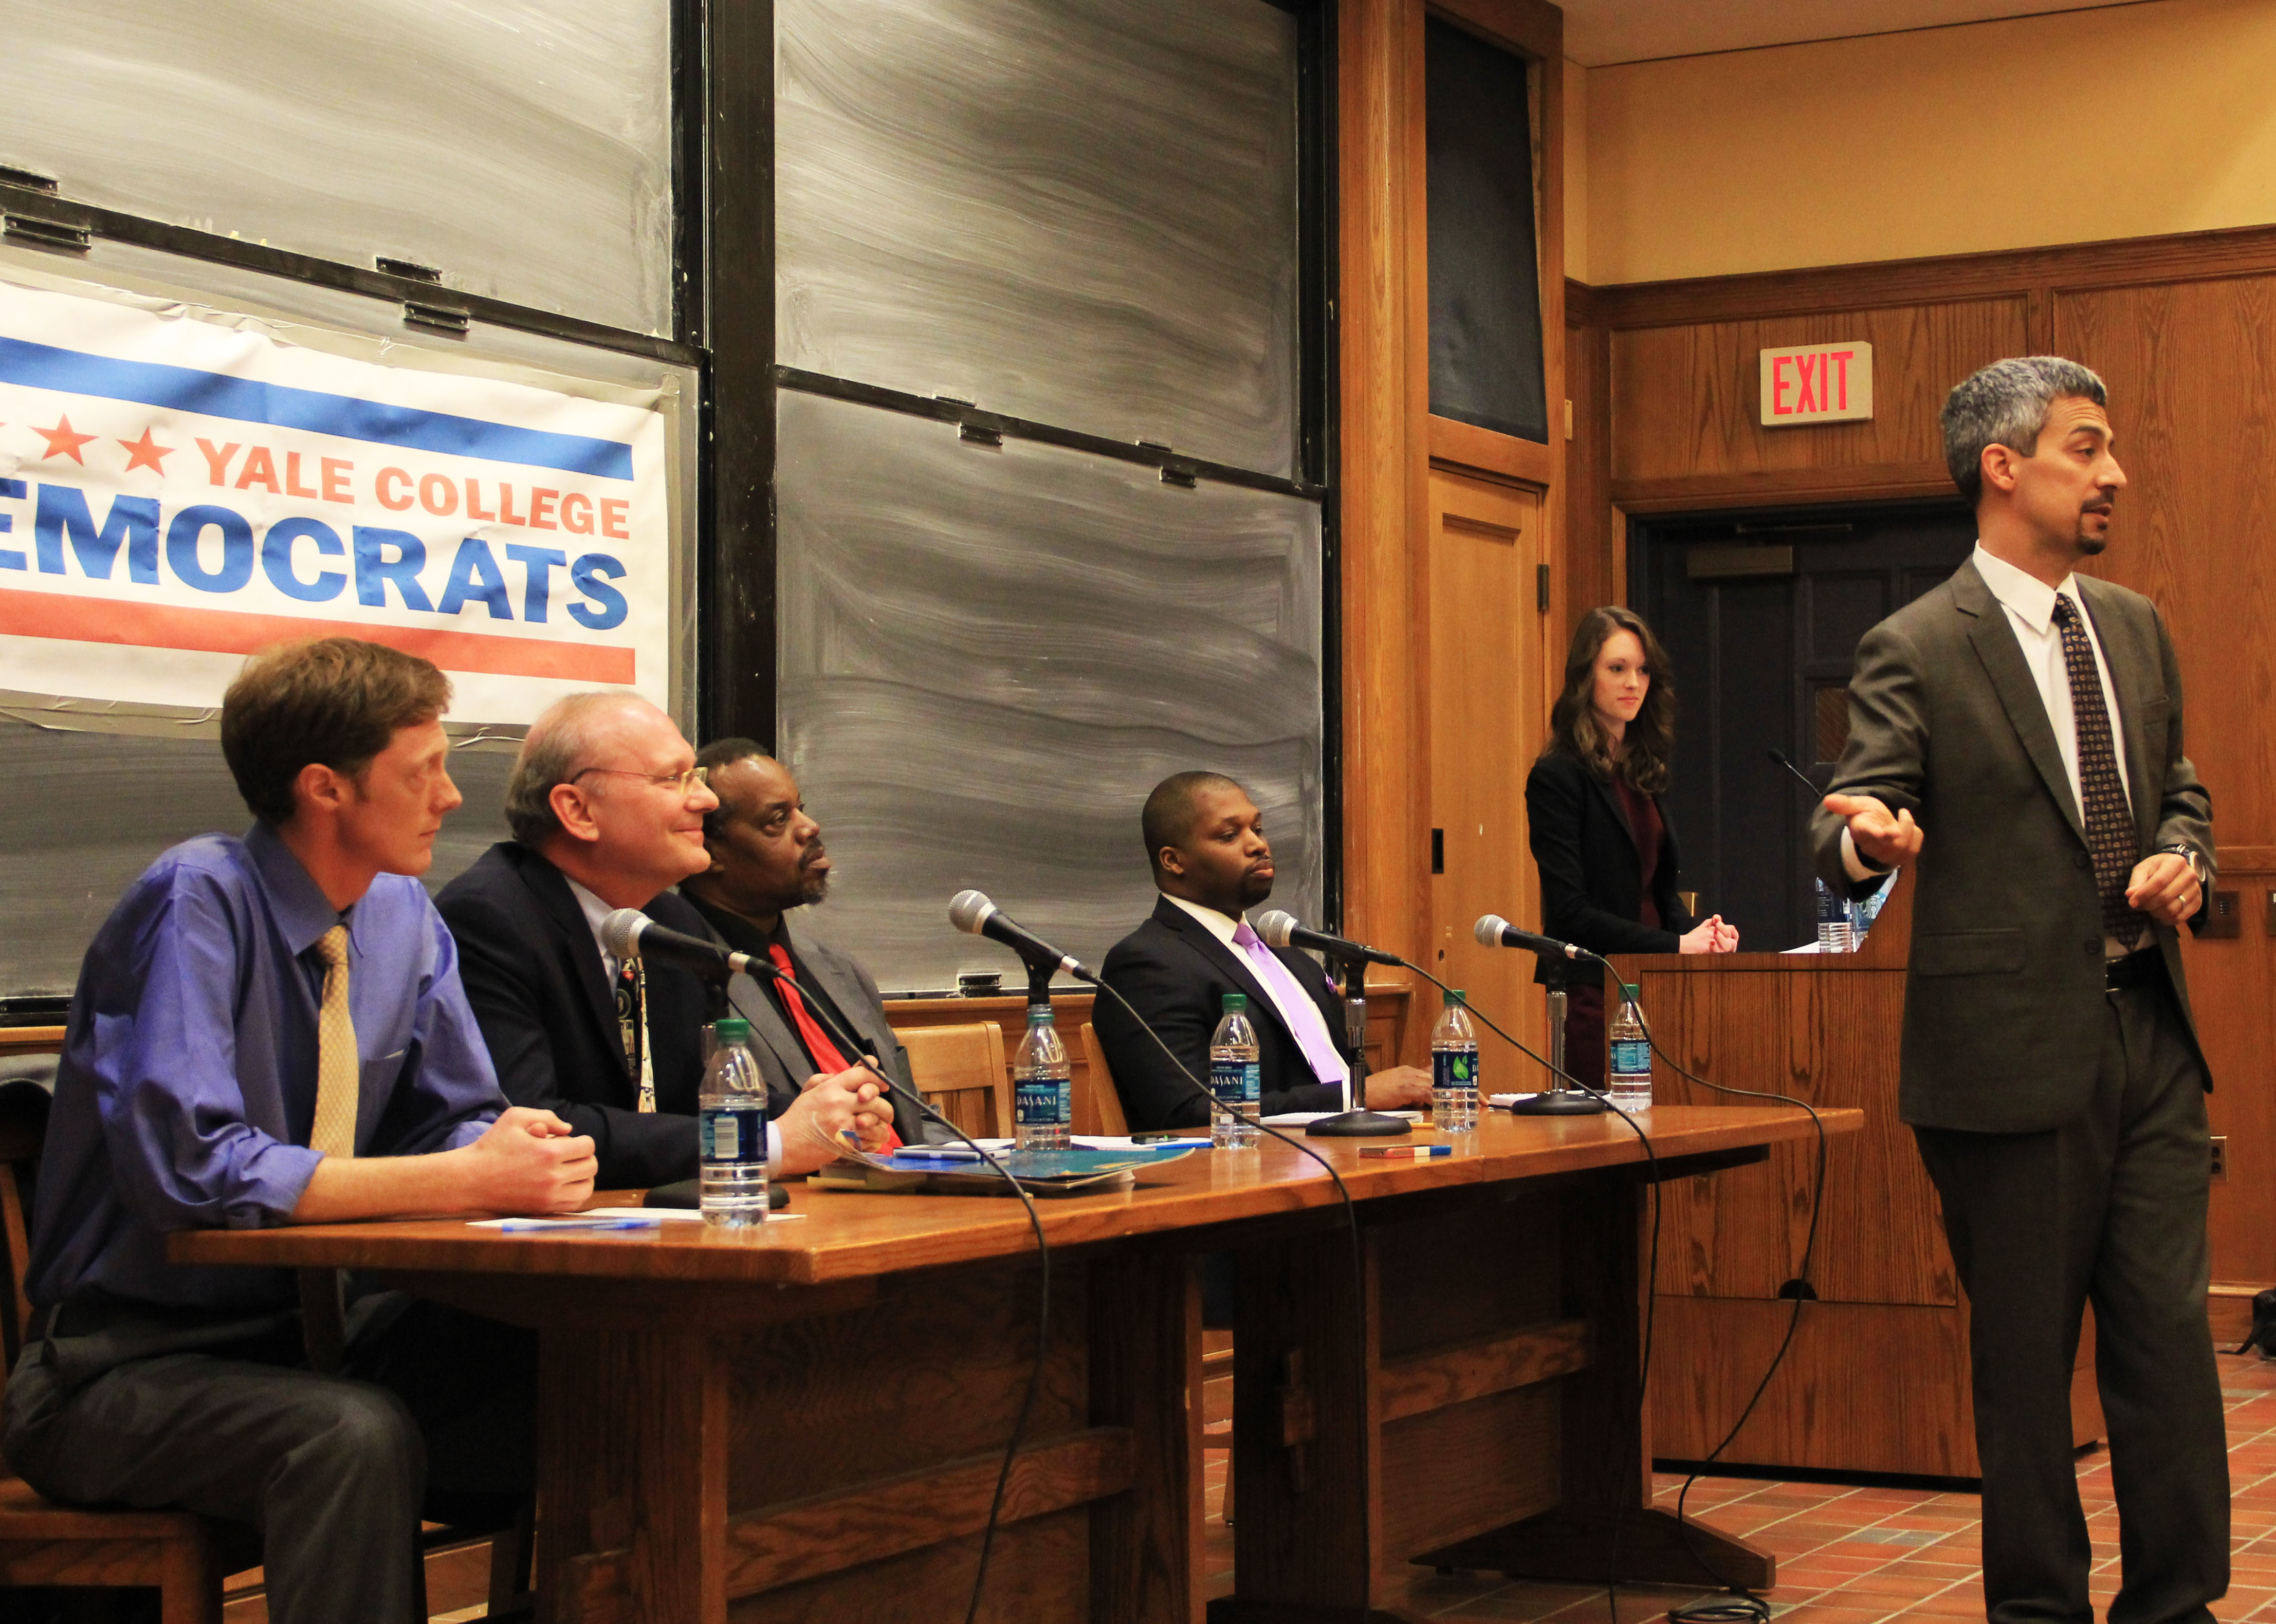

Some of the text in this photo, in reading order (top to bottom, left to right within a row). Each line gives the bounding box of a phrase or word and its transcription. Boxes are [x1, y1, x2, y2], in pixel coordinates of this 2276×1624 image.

[1773, 350, 1854, 415] EXIT
[194, 437, 630, 540] YALE COLLEGE
[1210, 1075, 1242, 1086] DASANI
[1017, 1095, 1056, 1106] DASANI
